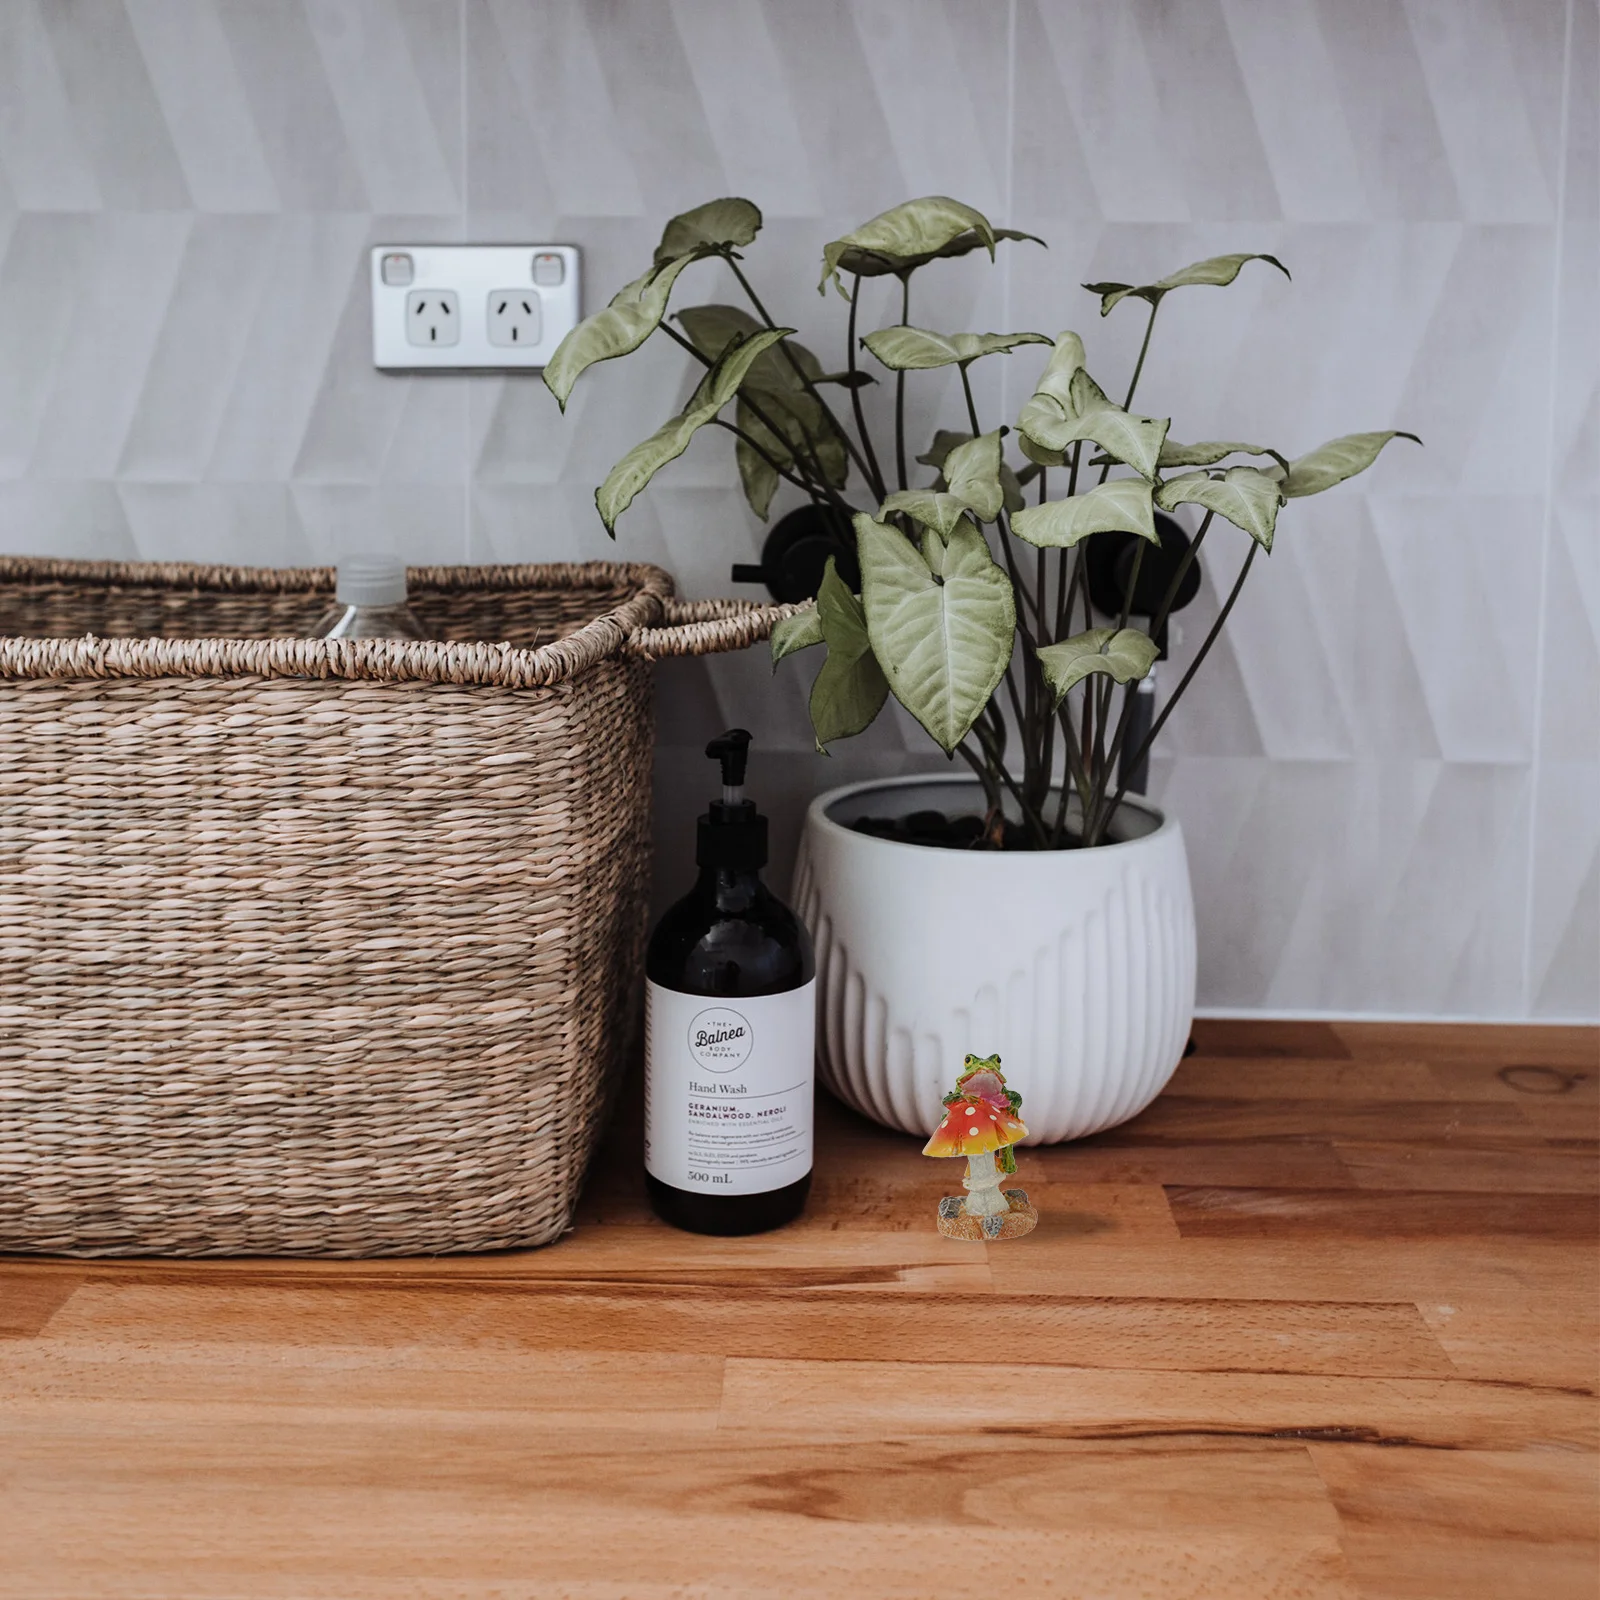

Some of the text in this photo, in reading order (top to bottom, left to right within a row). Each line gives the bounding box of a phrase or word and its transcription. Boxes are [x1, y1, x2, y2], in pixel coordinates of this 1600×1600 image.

[695, 1026, 746, 1047] Balnea
[689, 1081, 747, 1094] Hand Wash
[757, 1106, 786, 1117] NEROLI
[687, 1171, 733, 1184] 500 mL
